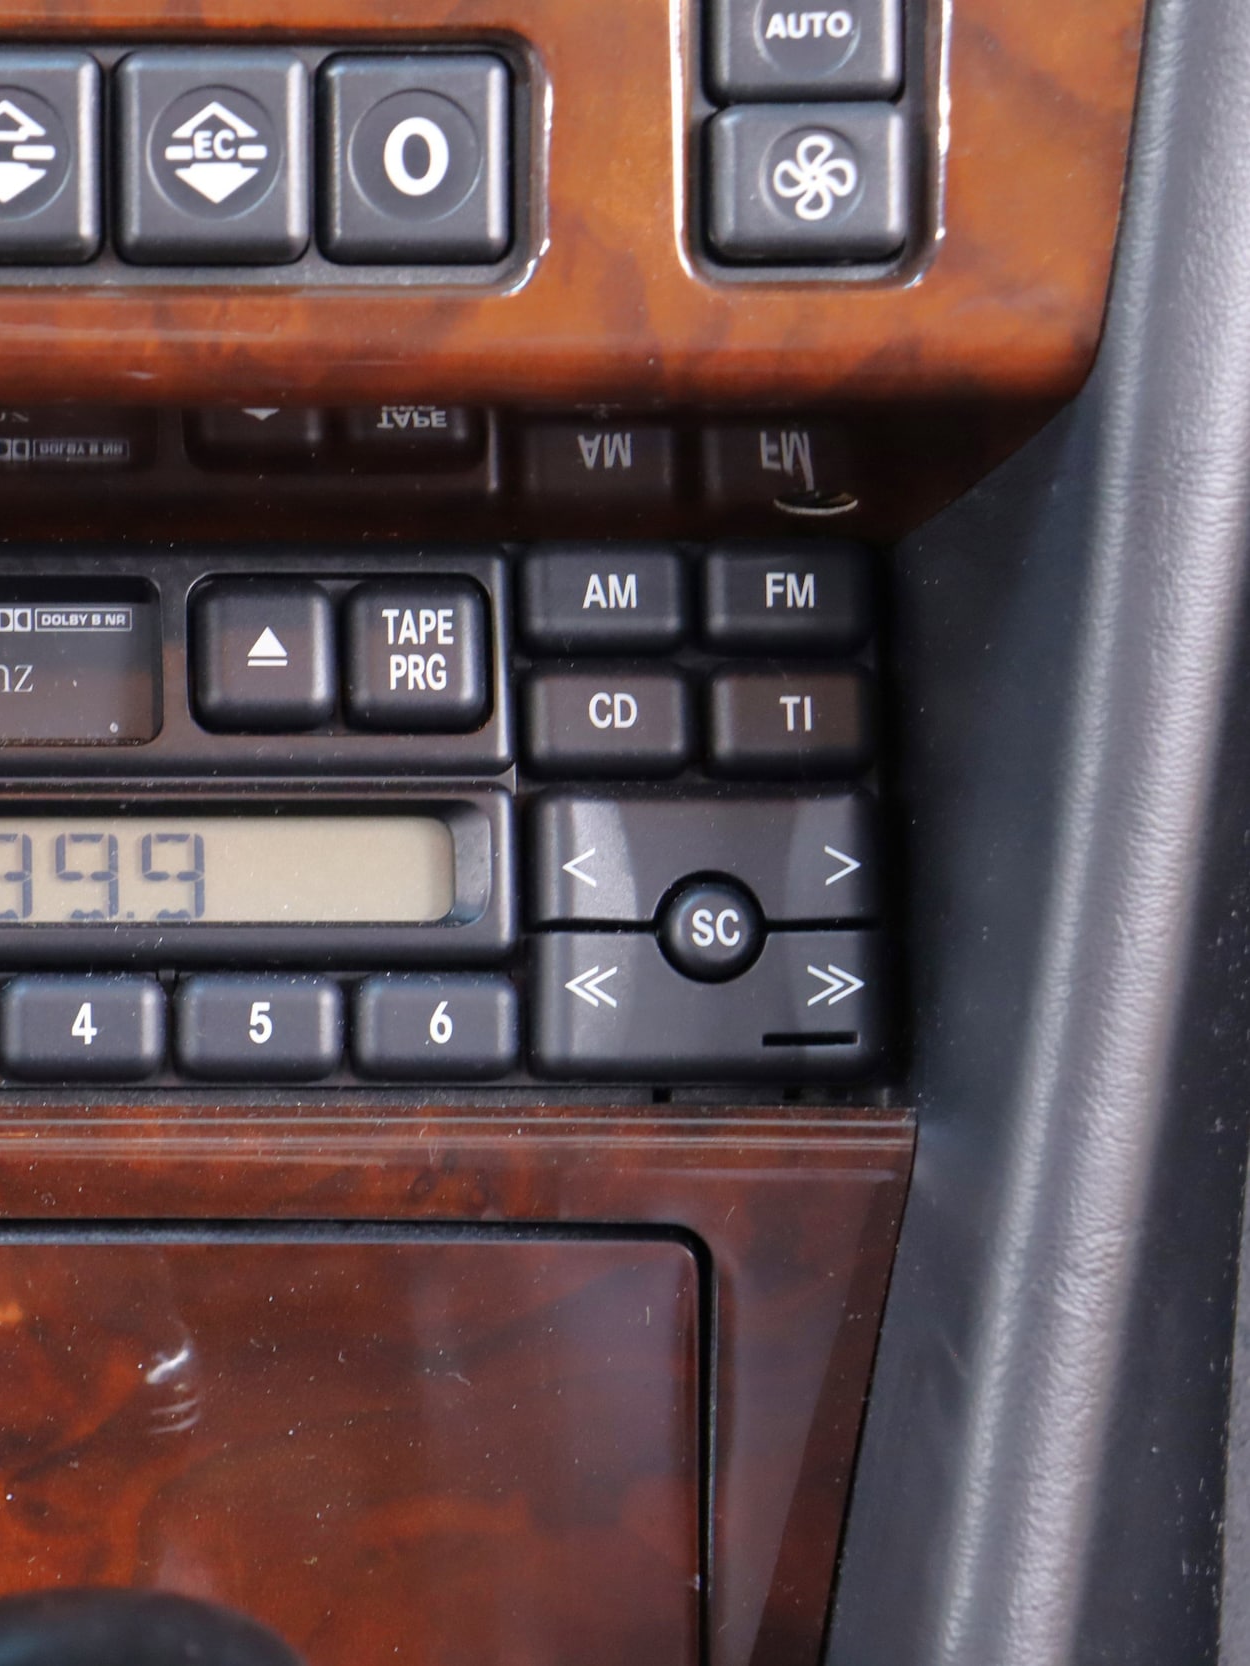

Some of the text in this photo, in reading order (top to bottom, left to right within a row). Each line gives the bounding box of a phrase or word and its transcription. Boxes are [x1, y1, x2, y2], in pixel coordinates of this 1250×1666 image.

[764, 11, 853, 41] AUTO
[191, 127, 236, 160] EC
[582, 574, 637, 609] AM
[765, 572, 815, 608] FM
[40, 613, 127, 627] DOLBY B NR
[382, 609, 454, 645] TAPE
[390, 653, 447, 691] PRG
[588, 692, 638, 729] CD
[779, 696, 812, 731] TI
[692, 909, 740, 947] SC
[71, 1002, 98, 1045] 4
[249, 1001, 273, 1044] 5
[429, 1001, 453, 1044] 6
